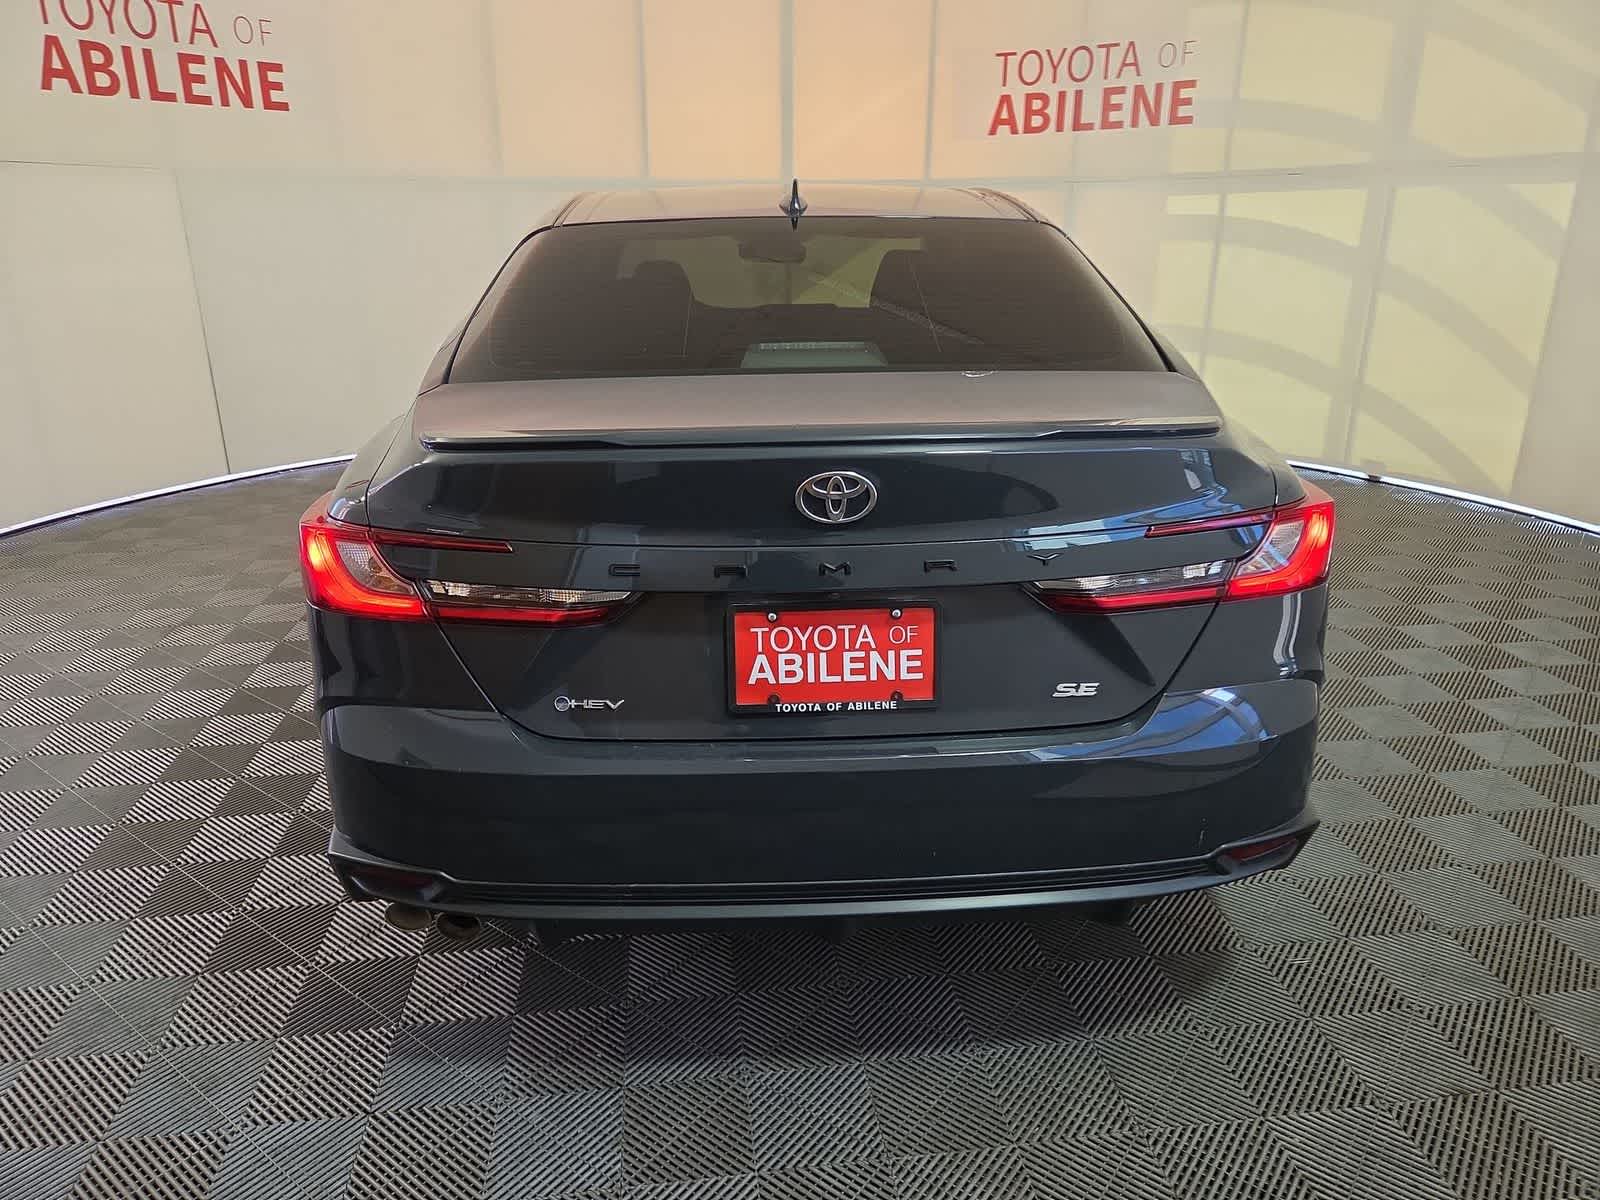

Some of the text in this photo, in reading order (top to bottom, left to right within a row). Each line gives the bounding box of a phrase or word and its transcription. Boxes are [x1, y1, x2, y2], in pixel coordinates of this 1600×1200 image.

[233, 15, 272, 46] OF
[41, 34, 290, 112] ABILENE
[995, 40, 1197, 87] TOYOTA OF
[987, 79, 1197, 135] ABILENE
[608, 552, 1062, 579] CAMRY
[750, 624, 919, 653] TOYOTA OF
[748, 649, 924, 685] ABILENE
[571, 699, 625, 709] HEV
[1052, 682, 1100, 697] SE
[776, 700, 898, 712] TOYOTA OF ABILENE
